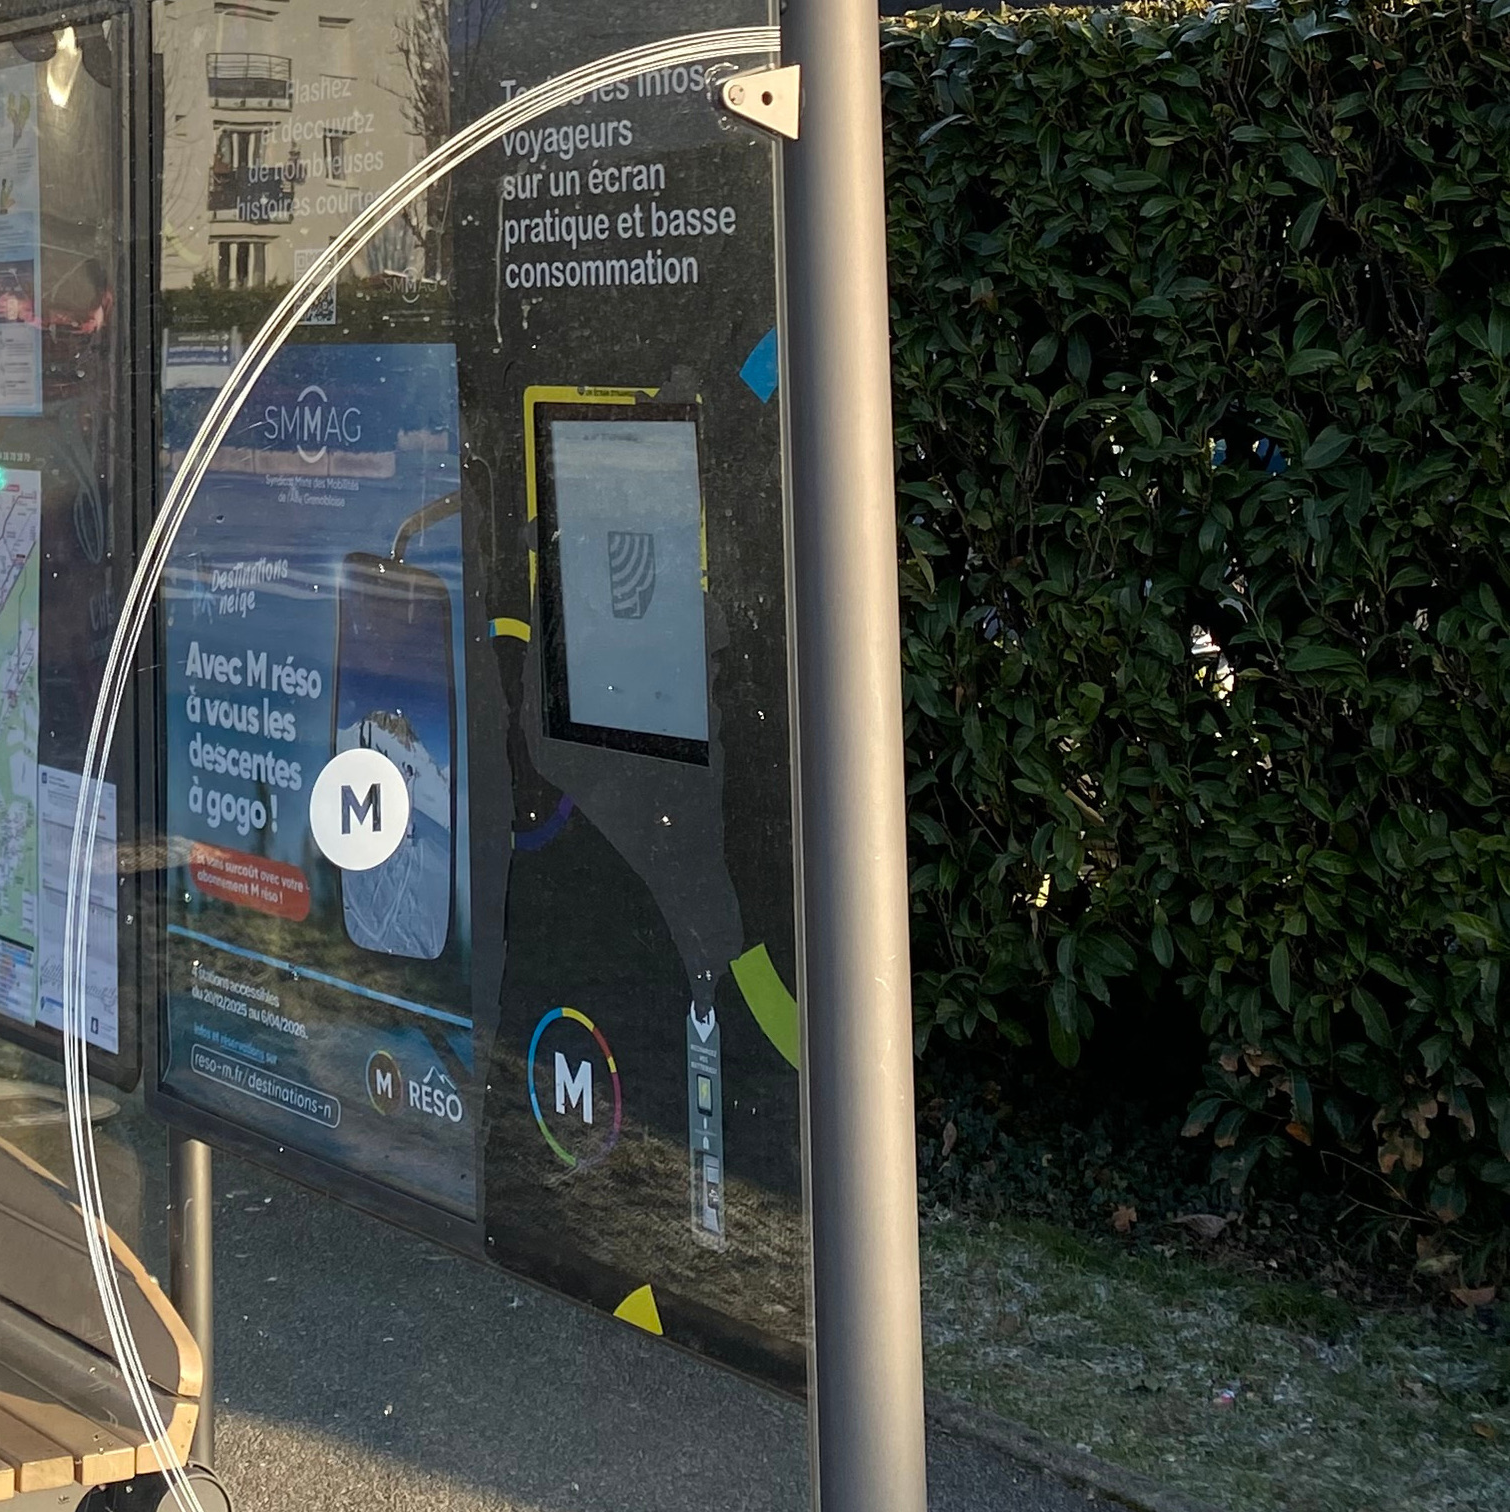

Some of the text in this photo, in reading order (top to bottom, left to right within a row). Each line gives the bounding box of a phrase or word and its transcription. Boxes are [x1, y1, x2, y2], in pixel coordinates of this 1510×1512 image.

[502, 119, 633, 163] voyageurs
[248, 158, 270, 183] de
[502, 159, 666, 201] sur un écran
[236, 194, 311, 221] histoires
[504, 201, 737, 254] pratique et basse
[505, 248, 699, 289] consommation
[264, 405, 362, 443] SMMAG
[219, 589, 256, 618] neige
[184, 641, 322, 699] Avec M réso
[204, 697, 260, 736] vous
[263, 697, 297, 742] les
[189, 731, 303, 792] descentes
[189, 775, 279, 836] à gogo !
[340, 782, 382, 835] M
[248, 1008, 261, 1022] au
[194, 1051, 332, 1119] reso-m.fr/destinations-n
[375, 1069, 393, 1099] M
[553, 1051, 593, 1125] M
